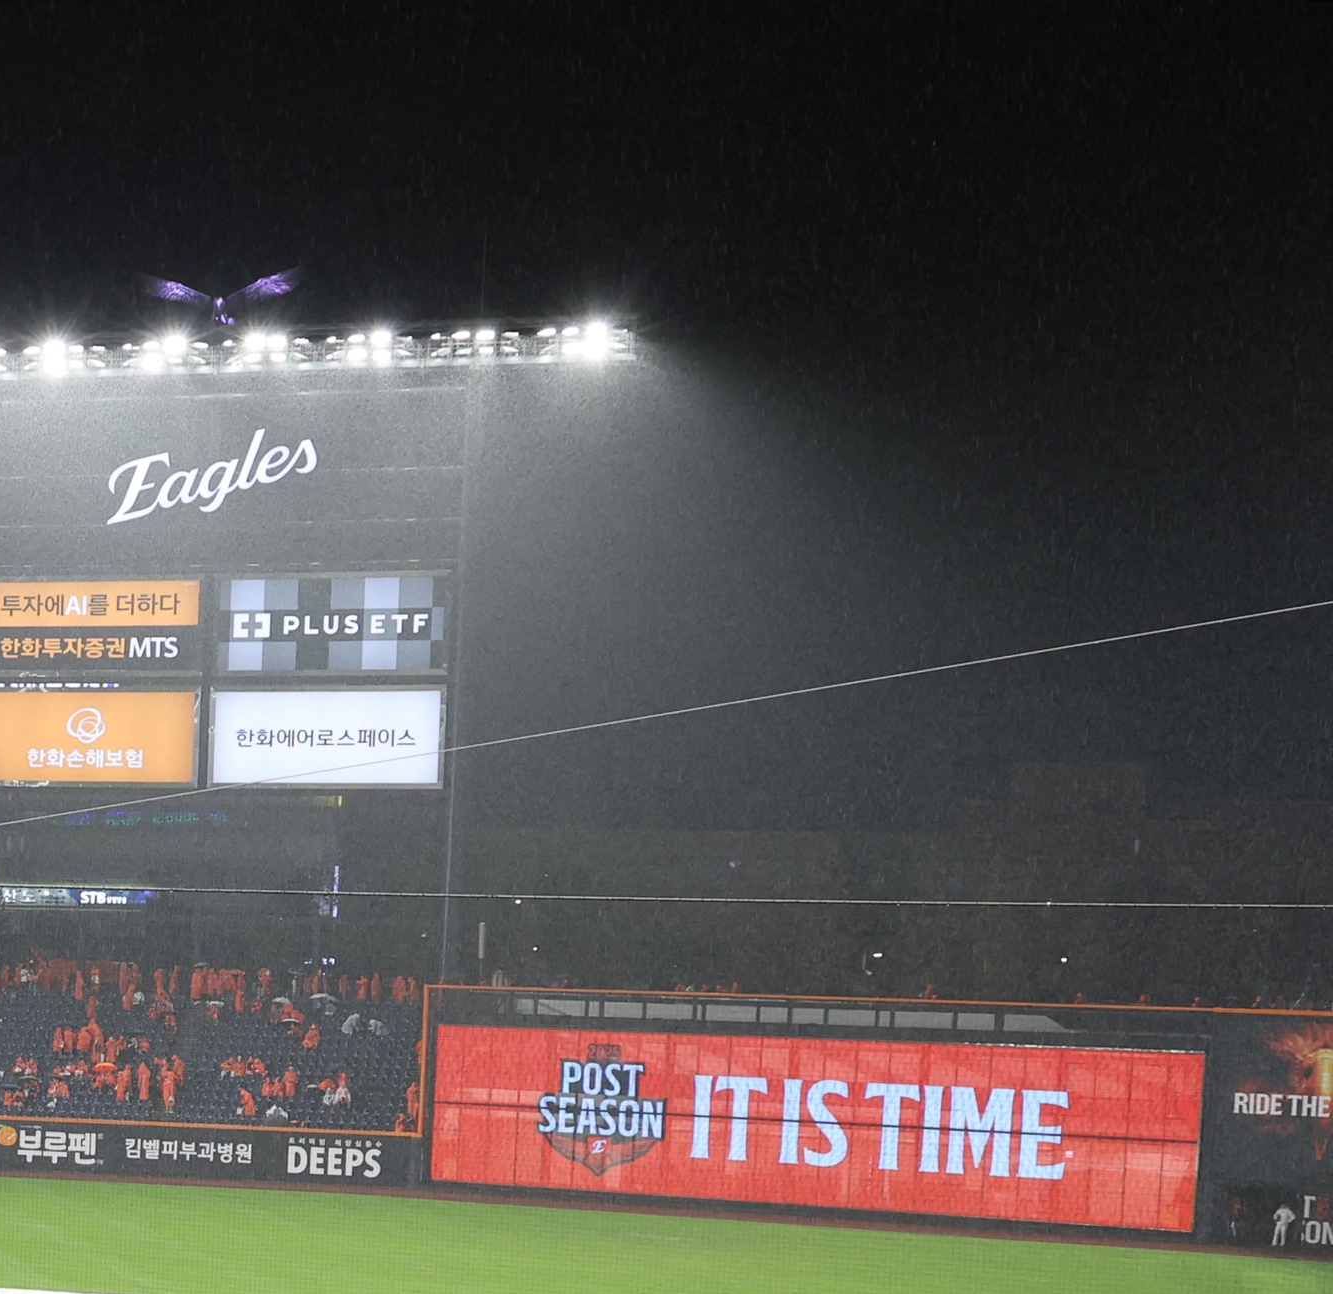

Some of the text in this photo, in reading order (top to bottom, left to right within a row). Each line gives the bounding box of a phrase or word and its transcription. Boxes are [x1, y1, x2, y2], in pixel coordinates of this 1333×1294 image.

[105, 427, 319, 526] Eagles
[115, 592, 181, 616] 더하다
[282, 613, 429, 636] PLUS ETF
[235, 728, 417, 748] 한화에어로스페이스
[26, 748, 144, 769] 한화손해보험
[561, 1061, 645, 1098] POST
[537, 1095, 664, 1139] SEASON
[1232, 1091, 1331, 1118] RIDE THE
[688, 1073, 1070, 1182] IT IS TIME
[17, 1129, 98, 1165] 부루펜
[124, 1137, 253, 1165] 킴벨피부과병원
[286, 1145, 383, 1178] DEEPS
